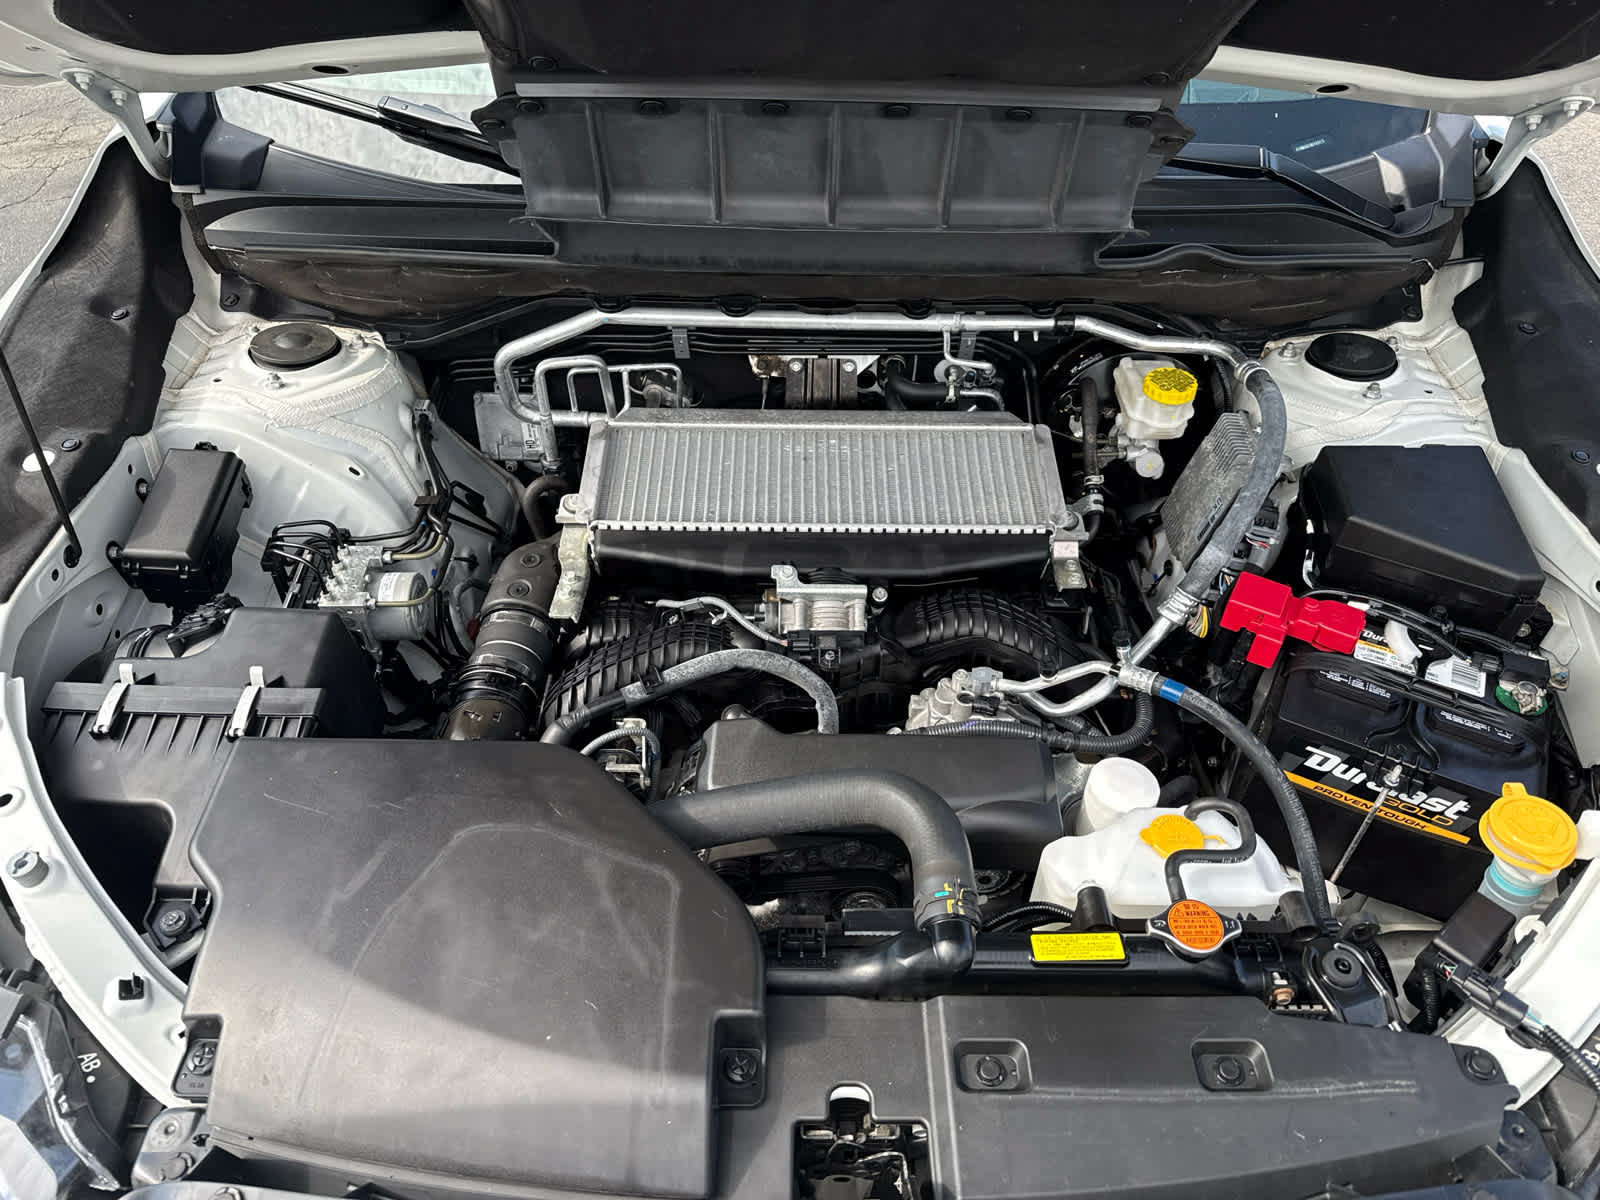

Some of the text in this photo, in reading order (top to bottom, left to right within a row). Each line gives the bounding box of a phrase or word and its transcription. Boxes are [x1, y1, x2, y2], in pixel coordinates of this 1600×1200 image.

[1312, 785, 1427, 830] PROVEN TOUGH
[77, 1052, 101, 1073] AB
